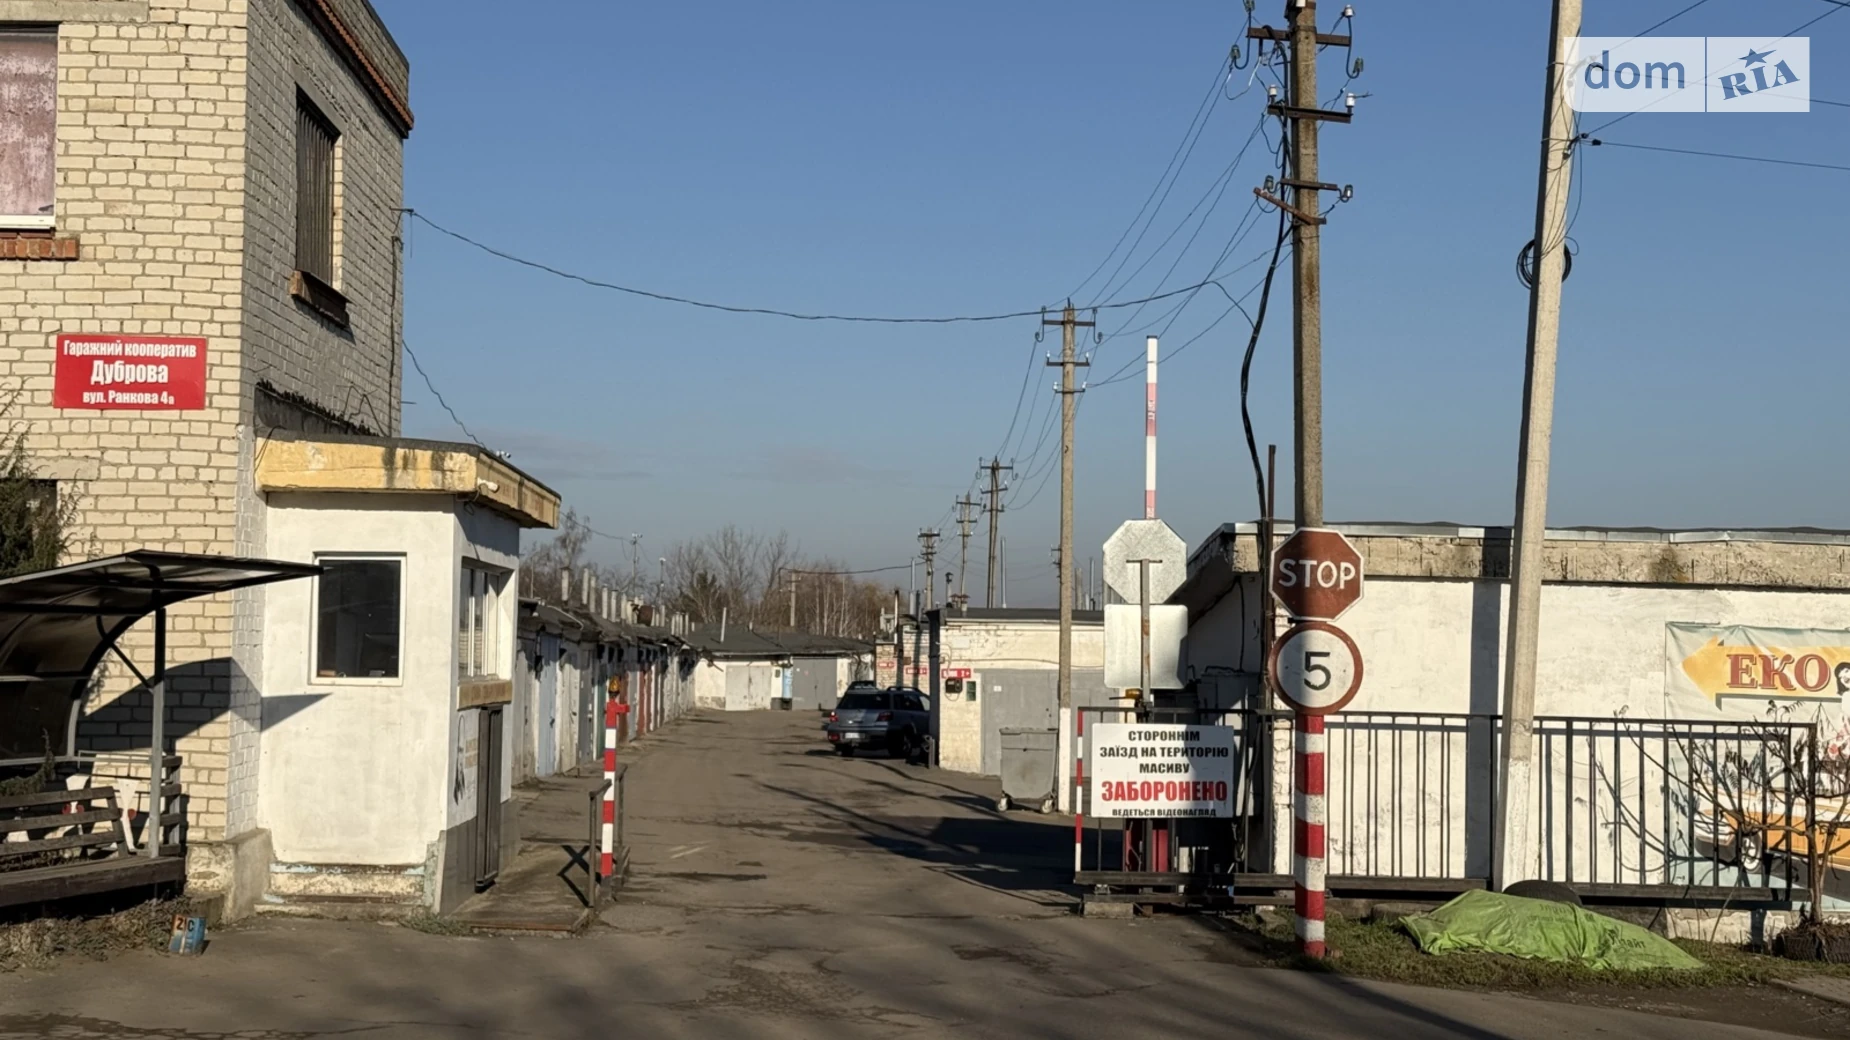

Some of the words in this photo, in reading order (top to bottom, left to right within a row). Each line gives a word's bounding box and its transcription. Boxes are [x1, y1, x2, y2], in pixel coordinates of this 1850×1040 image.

[63, 340, 122, 357] Гаражний
[124, 343, 197, 359] кооператив
[90, 360, 168, 385] Дуброва
[82, 391, 106, 405] вул.
[108, 390, 159, 405] Ранкова
[160, 391, 175, 405] 4а
[1278, 558, 1356, 590] STOP
[1303, 651, 1332, 691] 5
[1128, 730, 1200, 741] СТОРОННІМ
[1100, 746, 1138, 758] ЗАЇЗД
[1141, 747, 1157, 757] НА
[1160, 747, 1229, 758] ТЕРИТОРІЮ
[1139, 763, 1190, 774] МАСИВУ
[1101, 781, 1228, 802] ЗАБОРОНЕНО
[1112, 809, 1156, 817] ВЕДЕТЬСЯ
[1157, 809, 1217, 817] ВІДЕОНАГЛЯД
